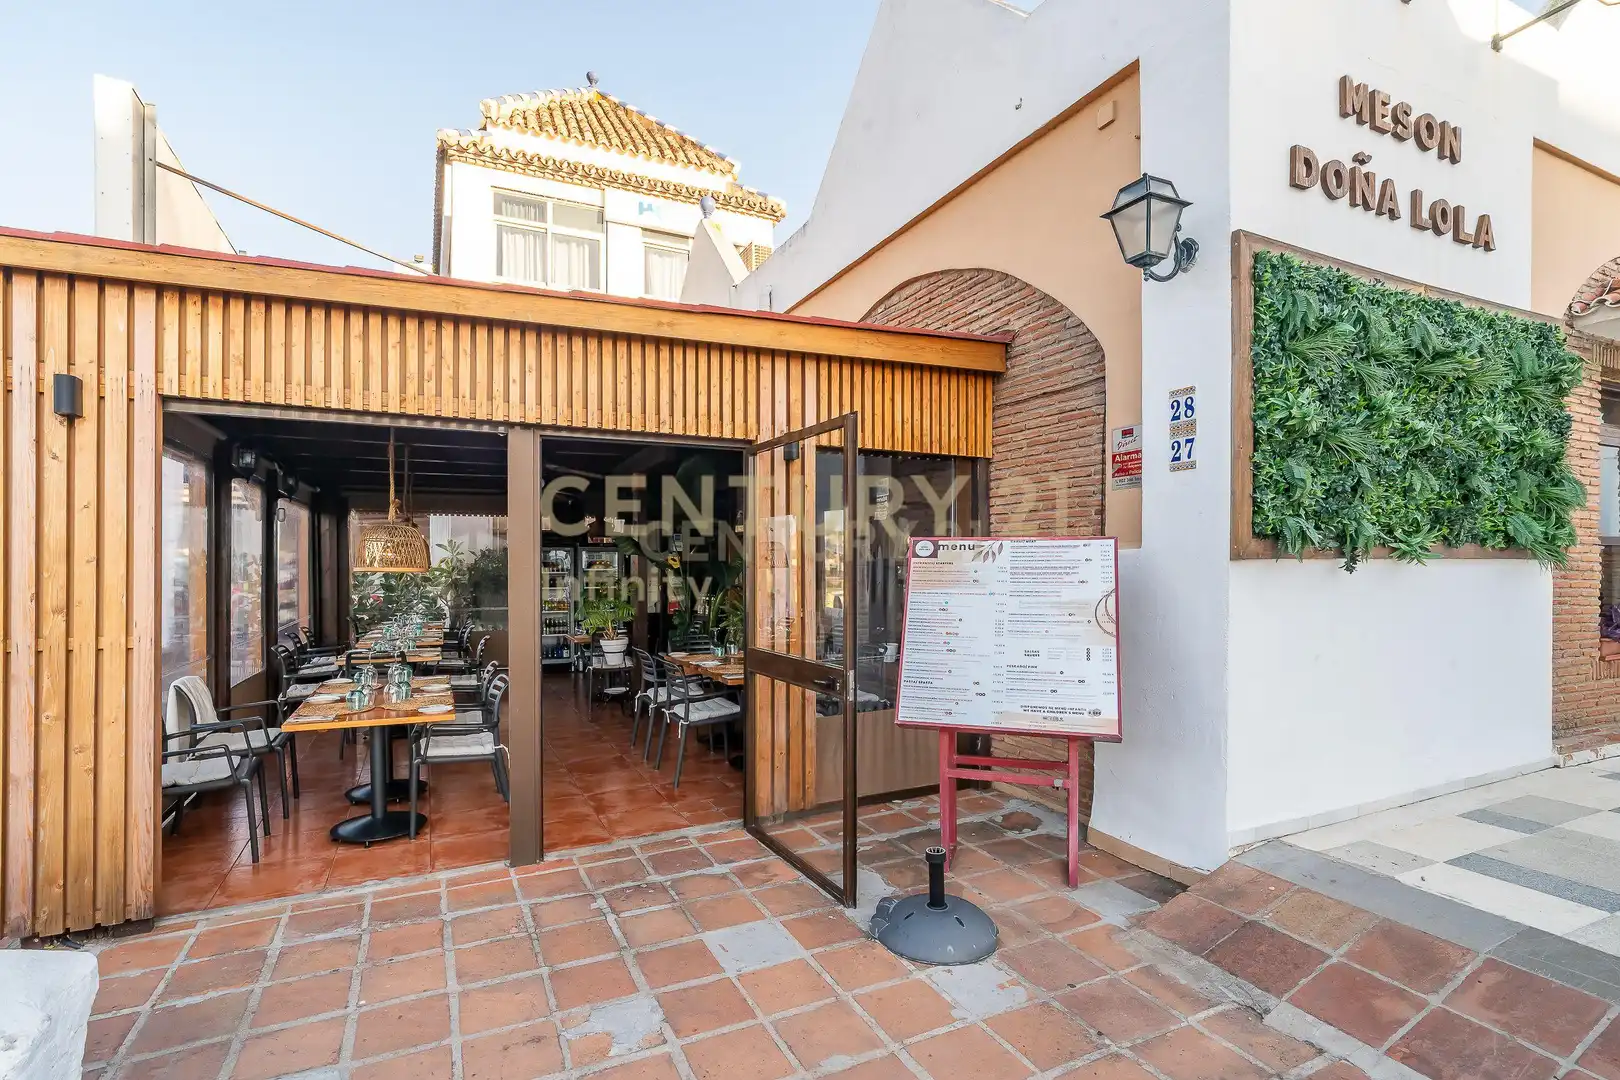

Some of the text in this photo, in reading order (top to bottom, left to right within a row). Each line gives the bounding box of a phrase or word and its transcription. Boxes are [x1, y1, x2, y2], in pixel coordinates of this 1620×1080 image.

[1338, 74, 1462, 165] MESON
[1289, 144, 1497, 252] DOÑA LOLA
[1170, 396, 1195, 422] 28
[1114, 452, 1142, 462] Alarma
[1170, 437, 1195, 463] 27
[938, 543, 976, 551] menu
